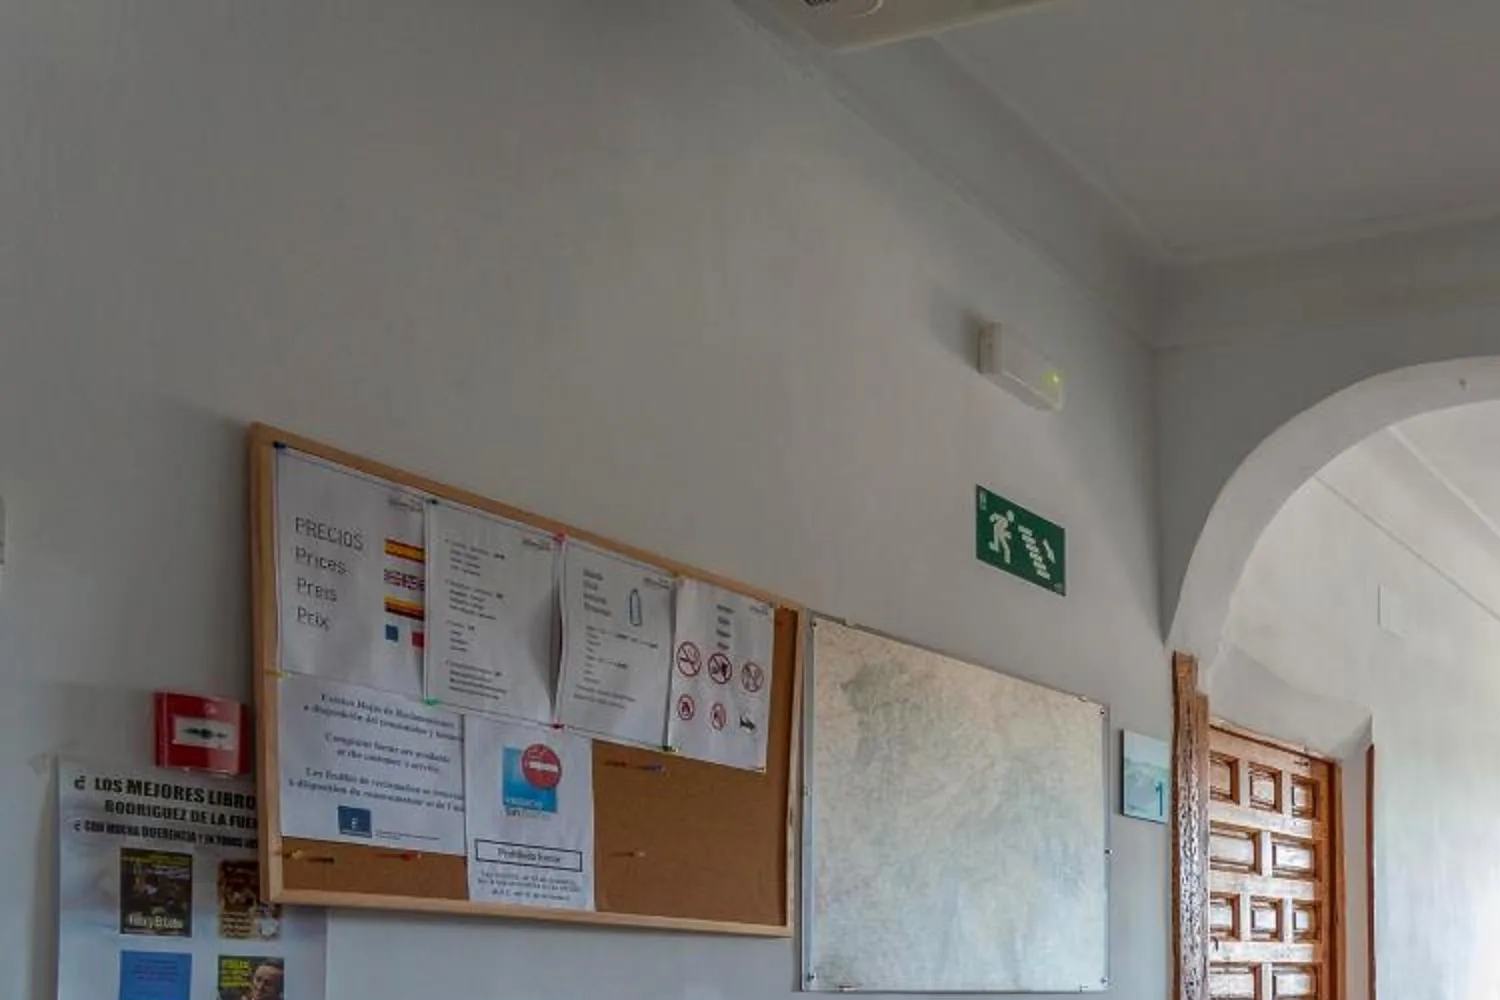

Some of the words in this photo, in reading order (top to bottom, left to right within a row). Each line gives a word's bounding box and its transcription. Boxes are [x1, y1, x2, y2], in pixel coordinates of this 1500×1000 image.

[295, 516, 364, 552] PRECIOS
[295, 546, 347, 575] Prices
[297, 576, 337, 603] Preis
[297, 607, 330, 632] Prix
[94, 777, 122, 792] LOS
[127, 779, 204, 805] MEJORES
[209, 790, 257, 810] LIBRO
[191, 808, 208, 824] DE
[210, 811, 226, 826] LA
